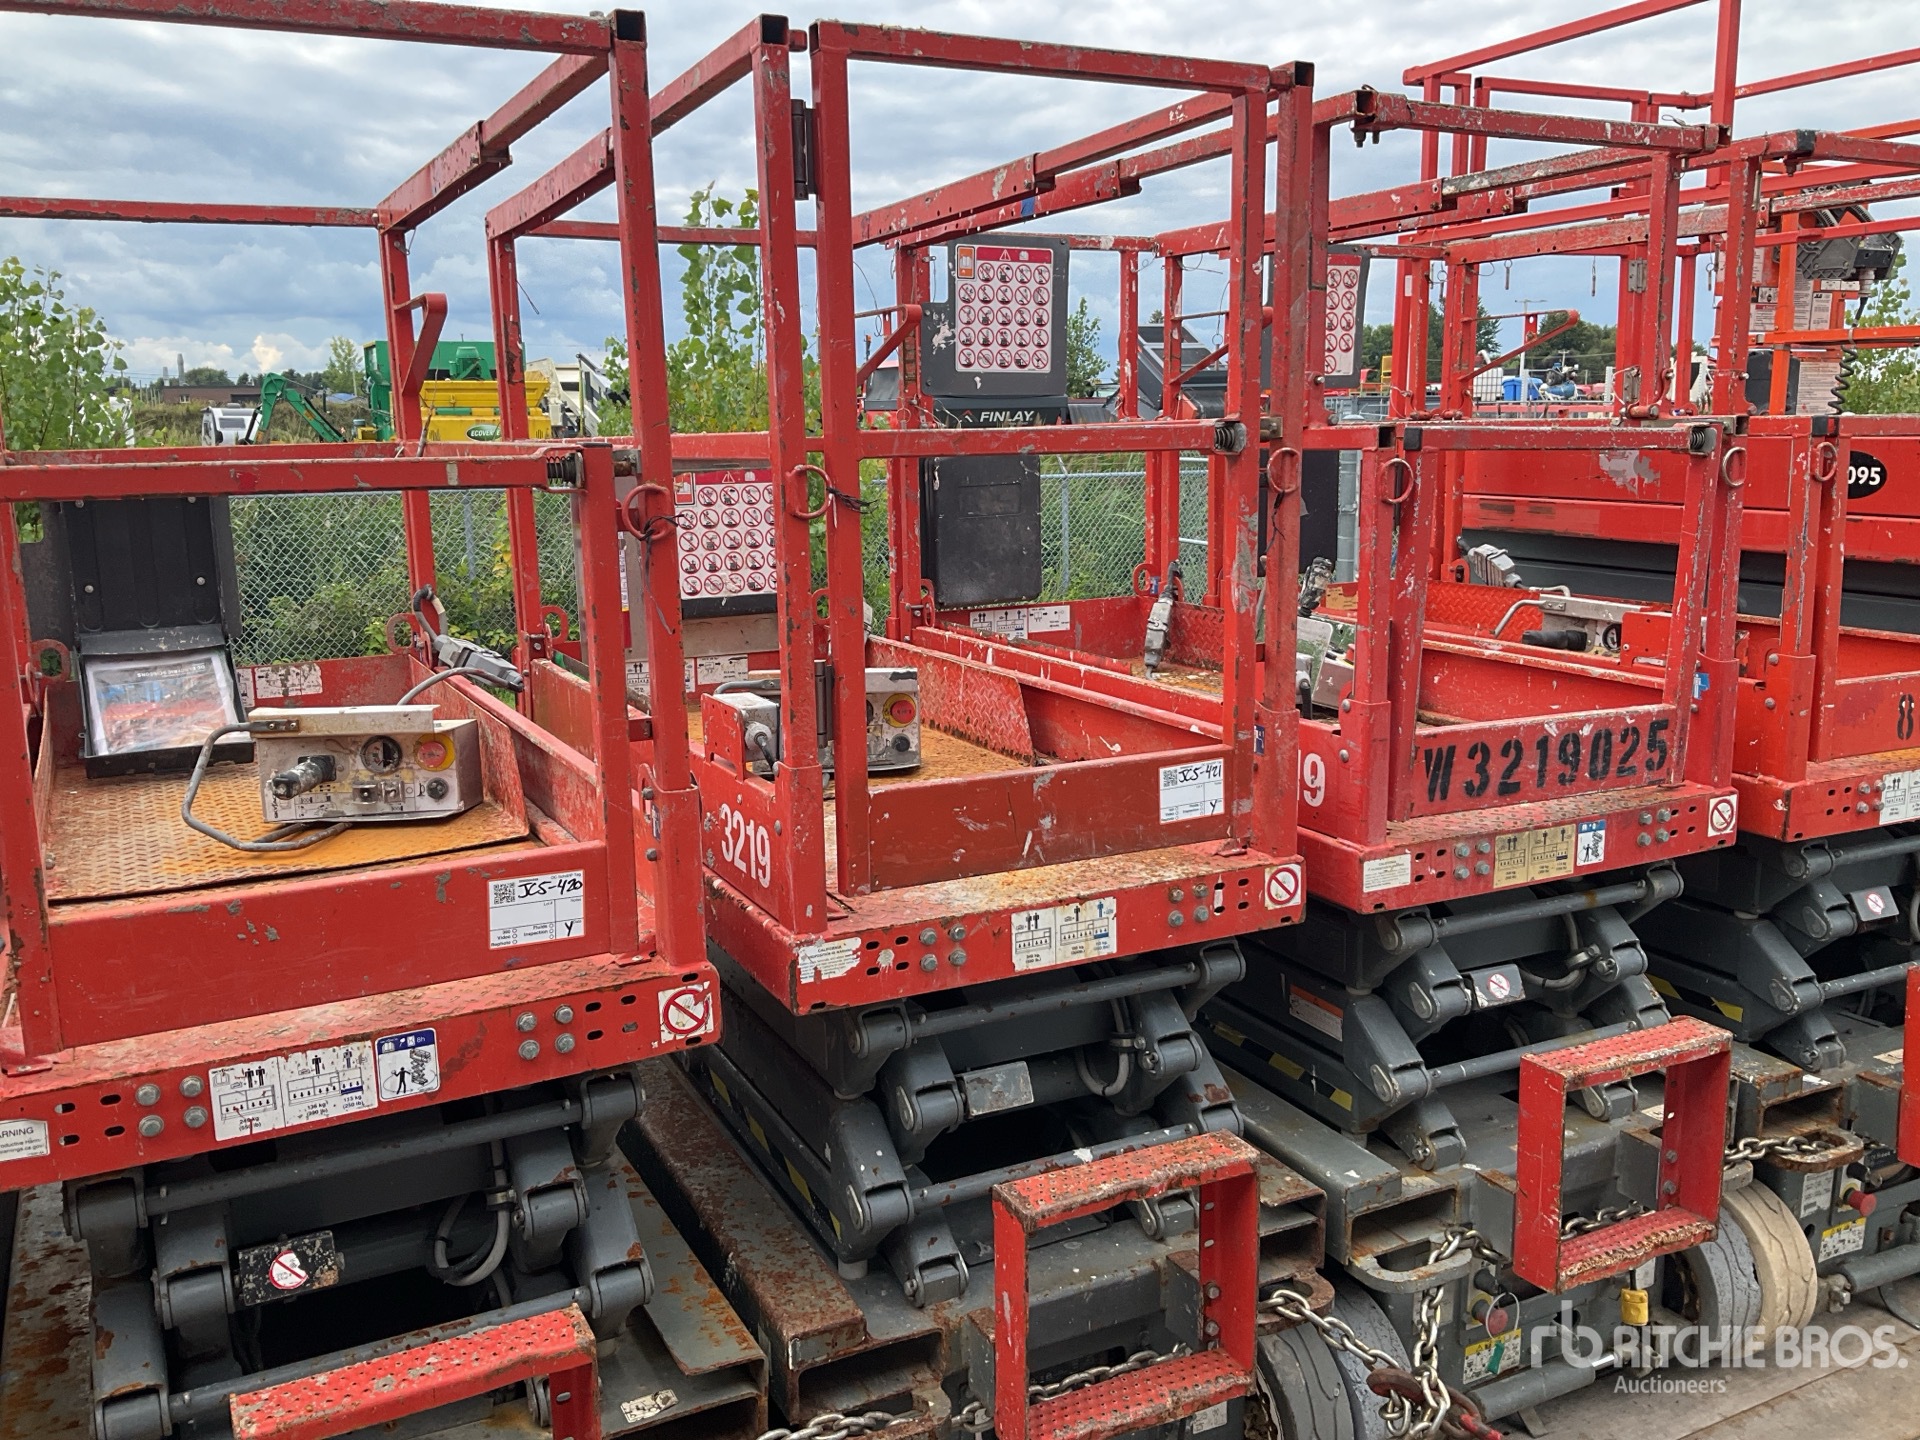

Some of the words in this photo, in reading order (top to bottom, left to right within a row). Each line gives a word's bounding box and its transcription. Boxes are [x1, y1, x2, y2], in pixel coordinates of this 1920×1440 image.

[980, 410, 1034, 423] FINLAY
[720, 803, 771, 888] 3219
[0, 1126, 34, 1138] RNING
